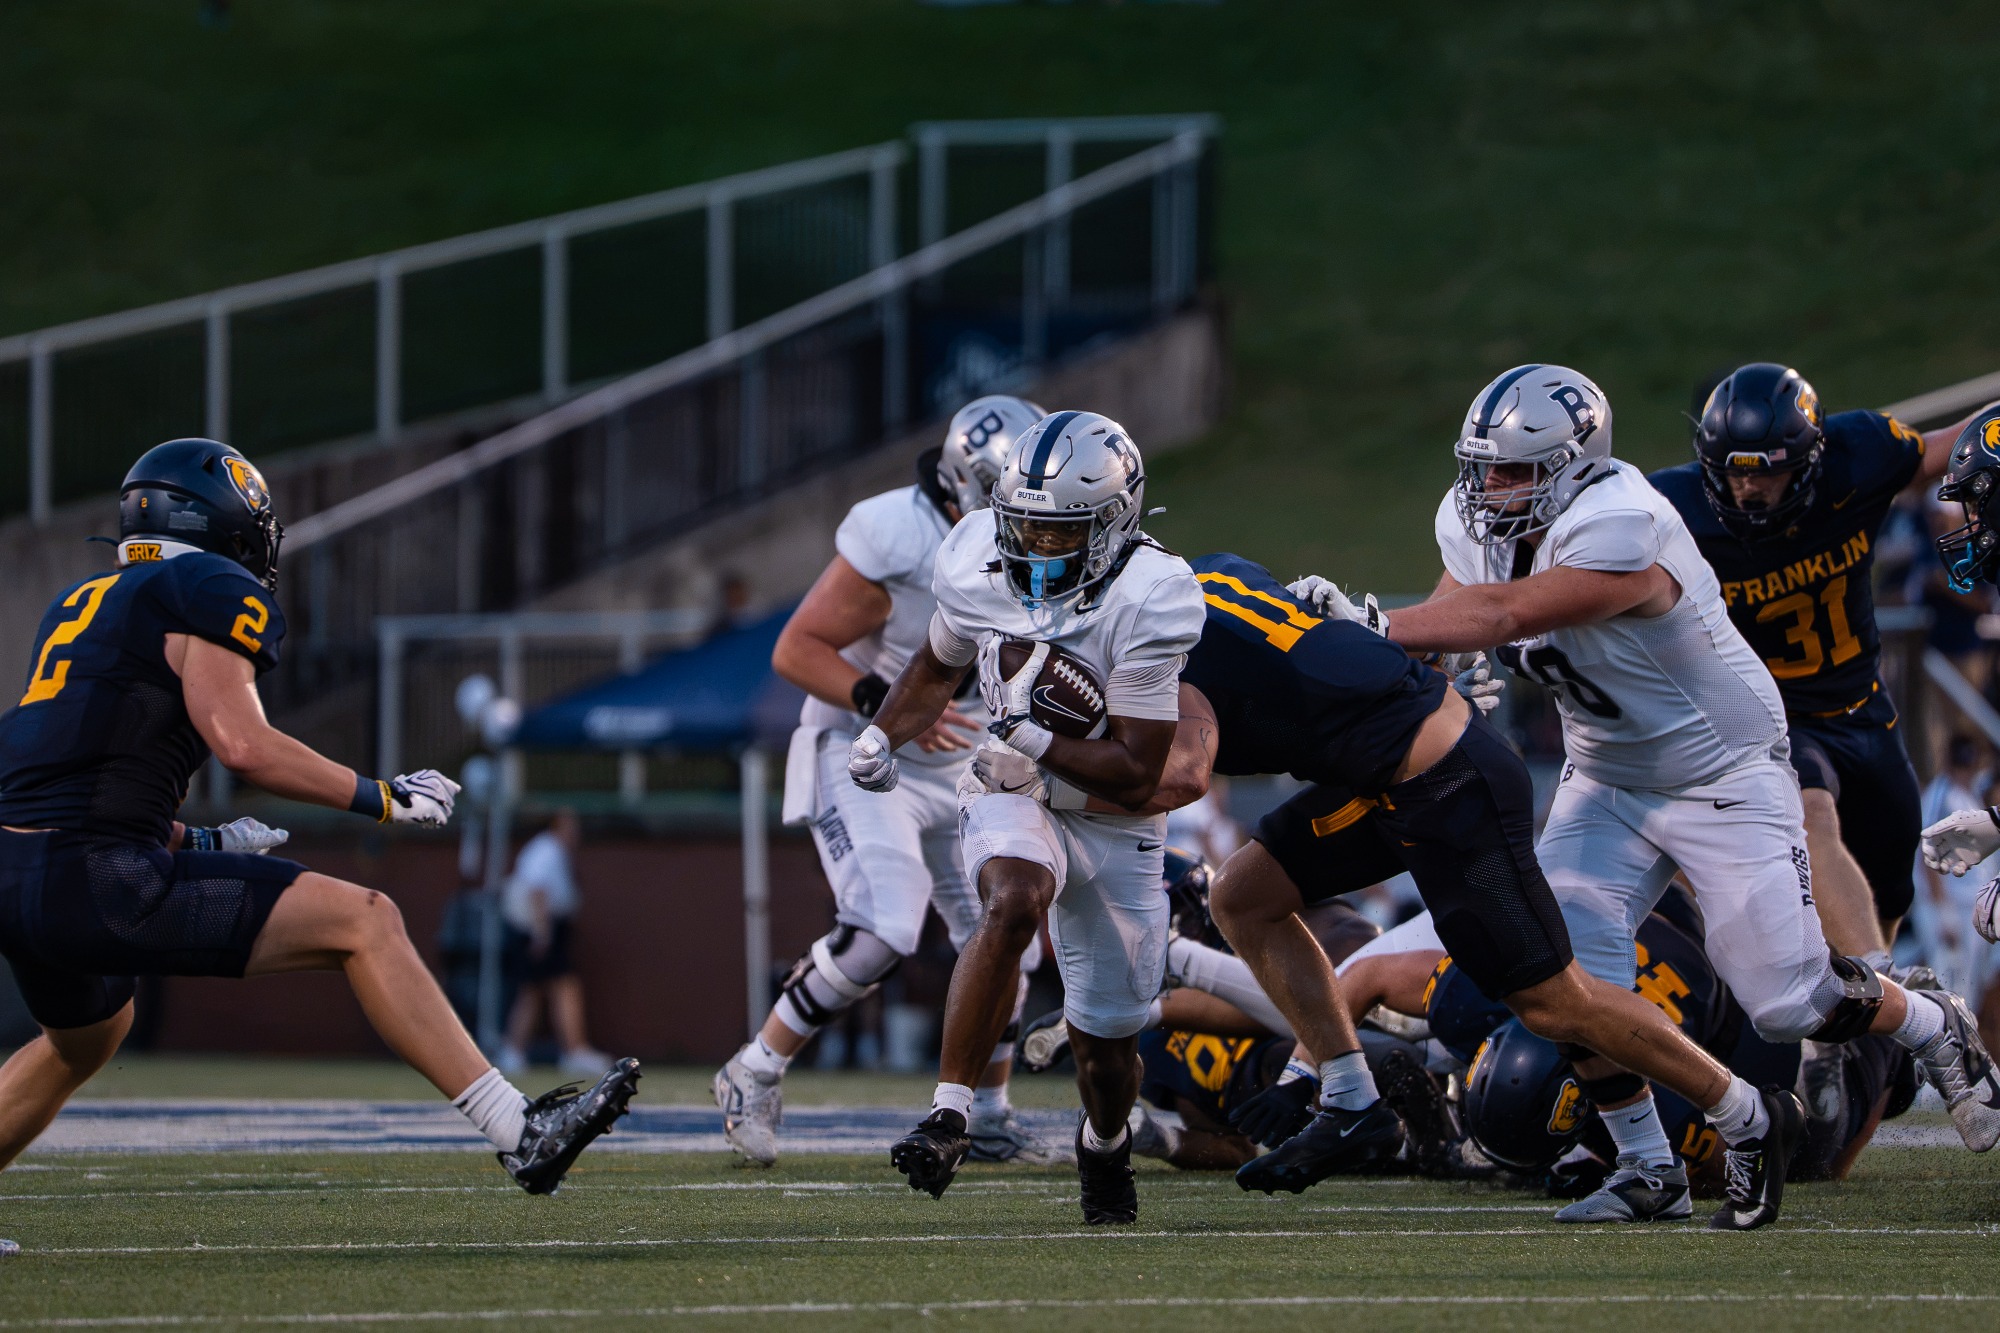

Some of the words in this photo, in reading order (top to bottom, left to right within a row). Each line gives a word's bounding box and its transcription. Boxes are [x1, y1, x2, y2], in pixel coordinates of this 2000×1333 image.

[963, 409, 1004, 449] B
[1550, 385, 1595, 437] B
[1103, 433, 1140, 486] B
[1466, 440, 1489, 450] BUTLER
[1017, 490, 1047, 502] BUTLER
[126, 543, 163, 562] GRIZ
[1721, 530, 1870, 607] FRANKLIN
[19, 573, 122, 706] 2
[230, 596, 269, 654] 2
[1756, 574, 1862, 680] 31
